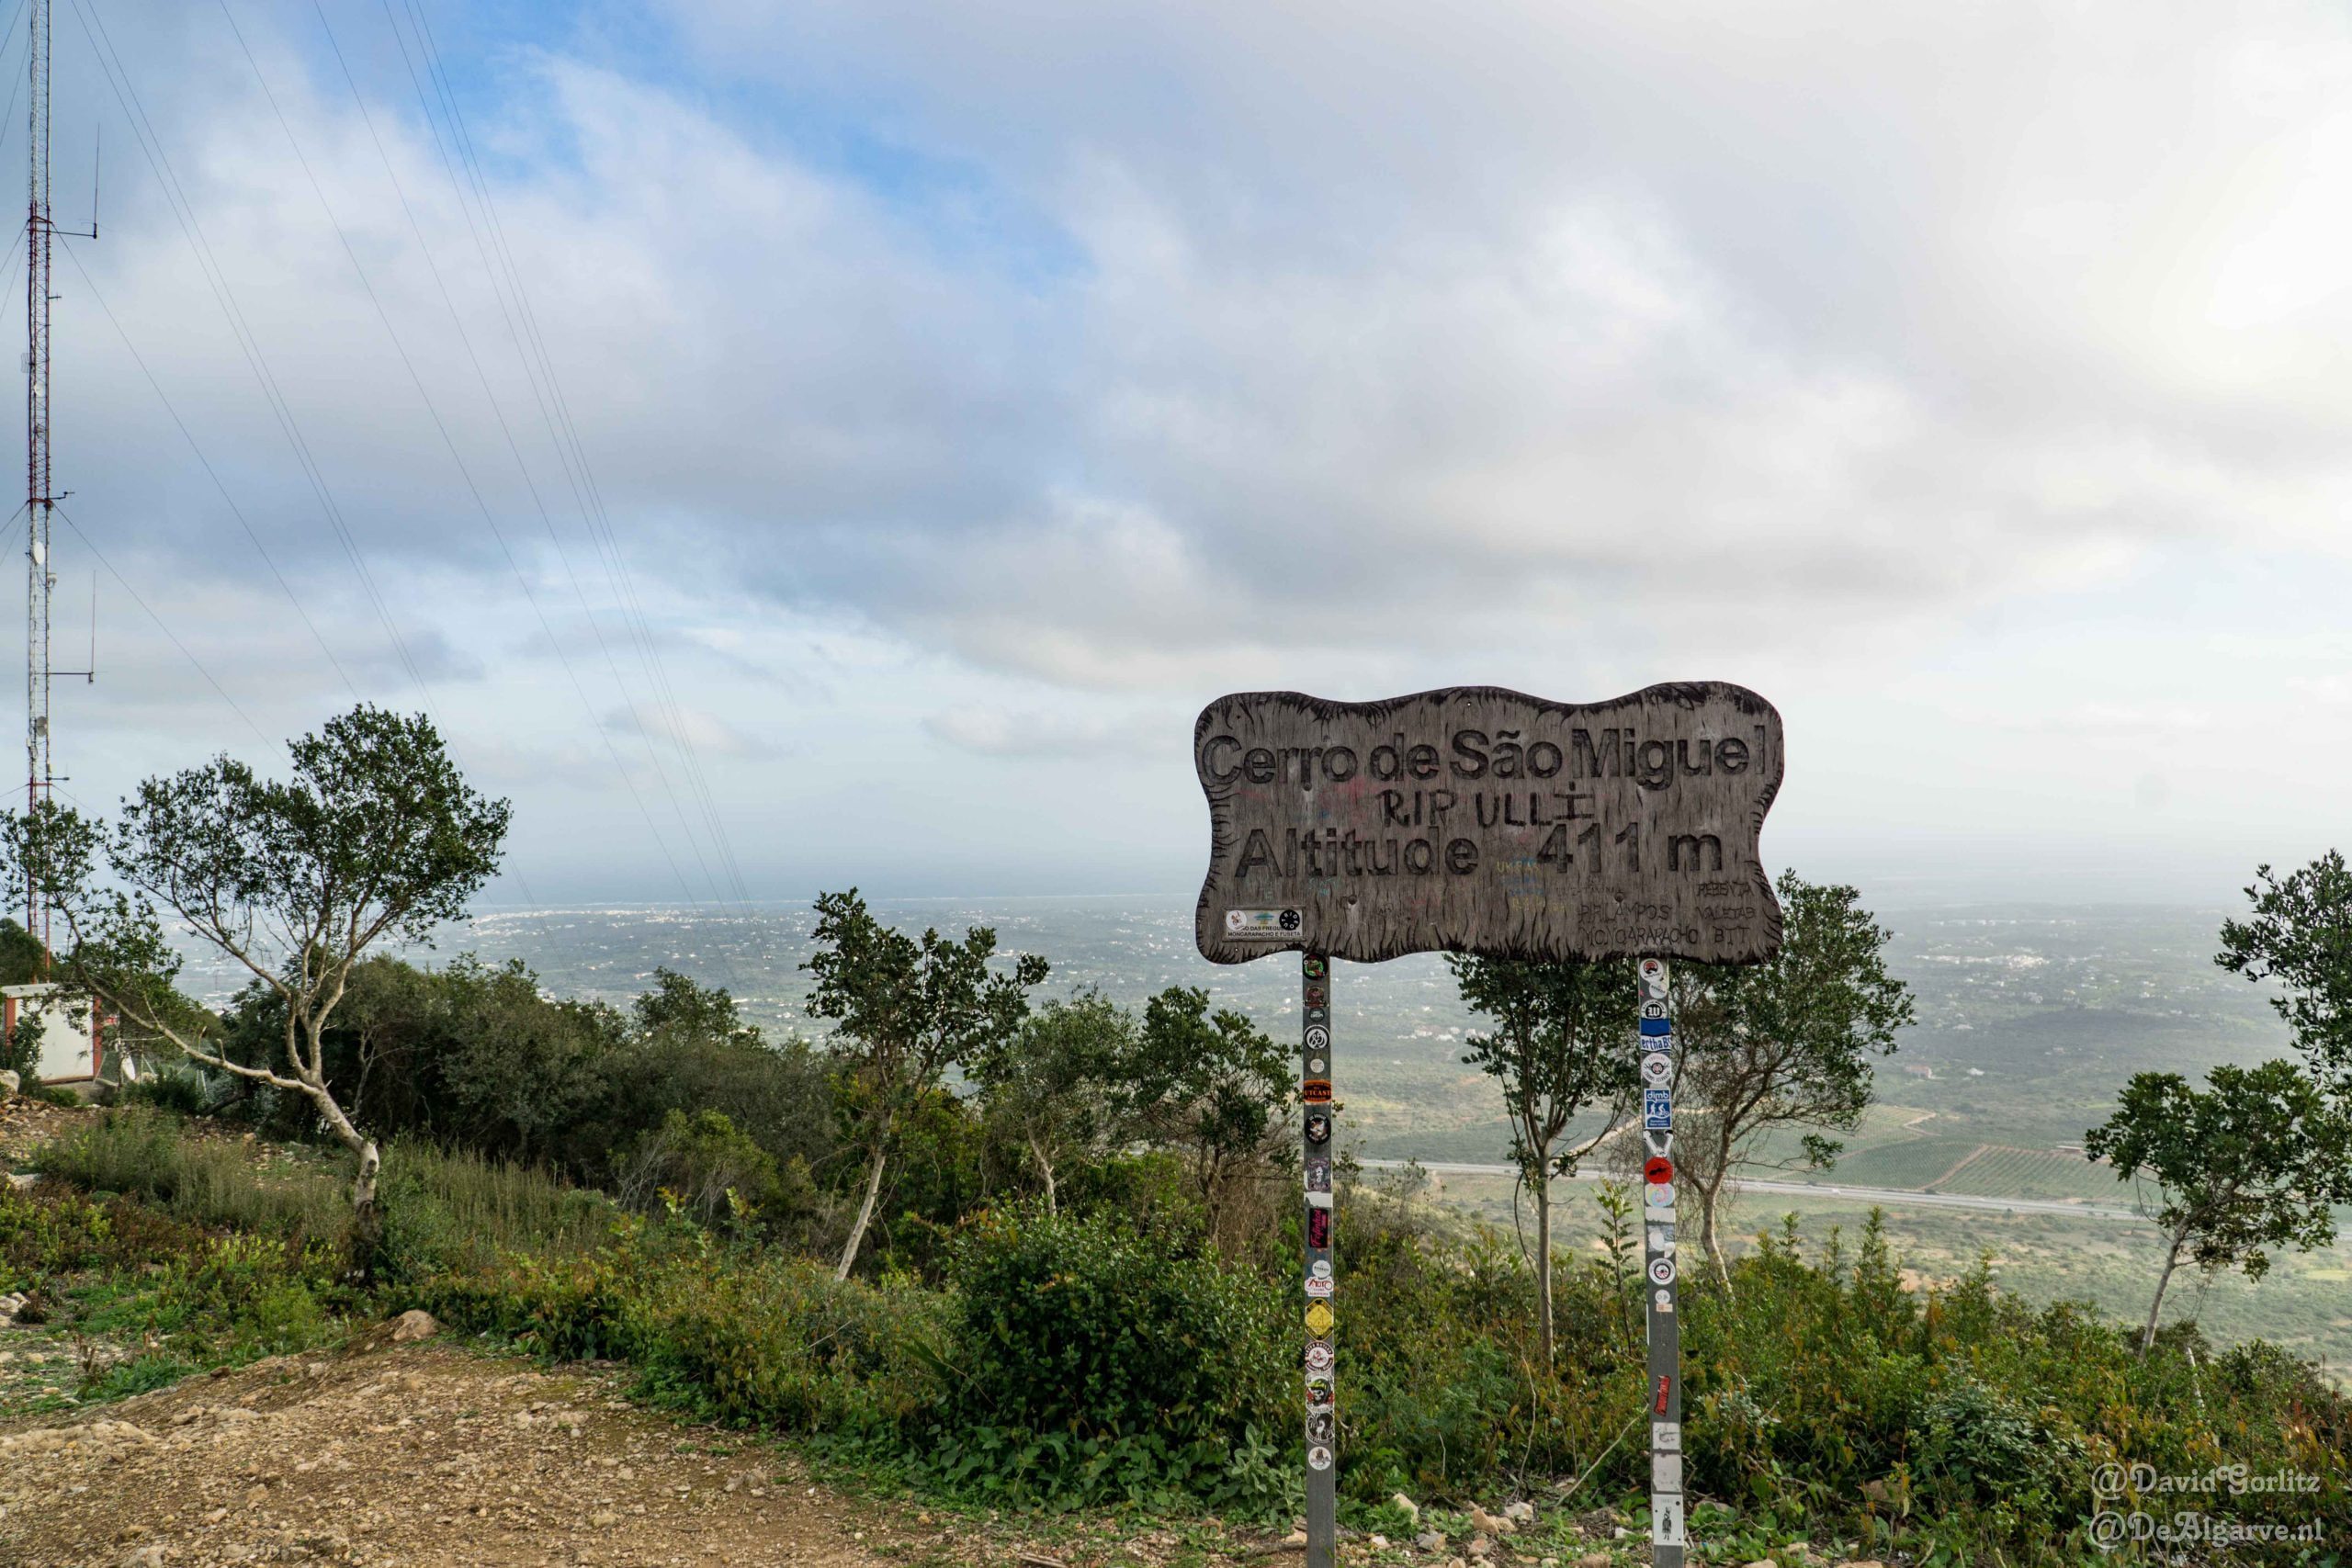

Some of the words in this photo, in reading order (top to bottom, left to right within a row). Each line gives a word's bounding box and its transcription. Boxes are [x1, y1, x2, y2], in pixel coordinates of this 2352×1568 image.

[1202, 735, 1358, 784] Cerro
[1369, 733, 1440, 780] de
[1449, 728, 1562, 780] São
[1572, 724, 1765, 791] Miguel
[1375, 789, 1458, 826] RIP
[1236, 826, 1479, 878] Altitude
[1537, 822, 1640, 874] 411
[1668, 830, 1722, 872] m
